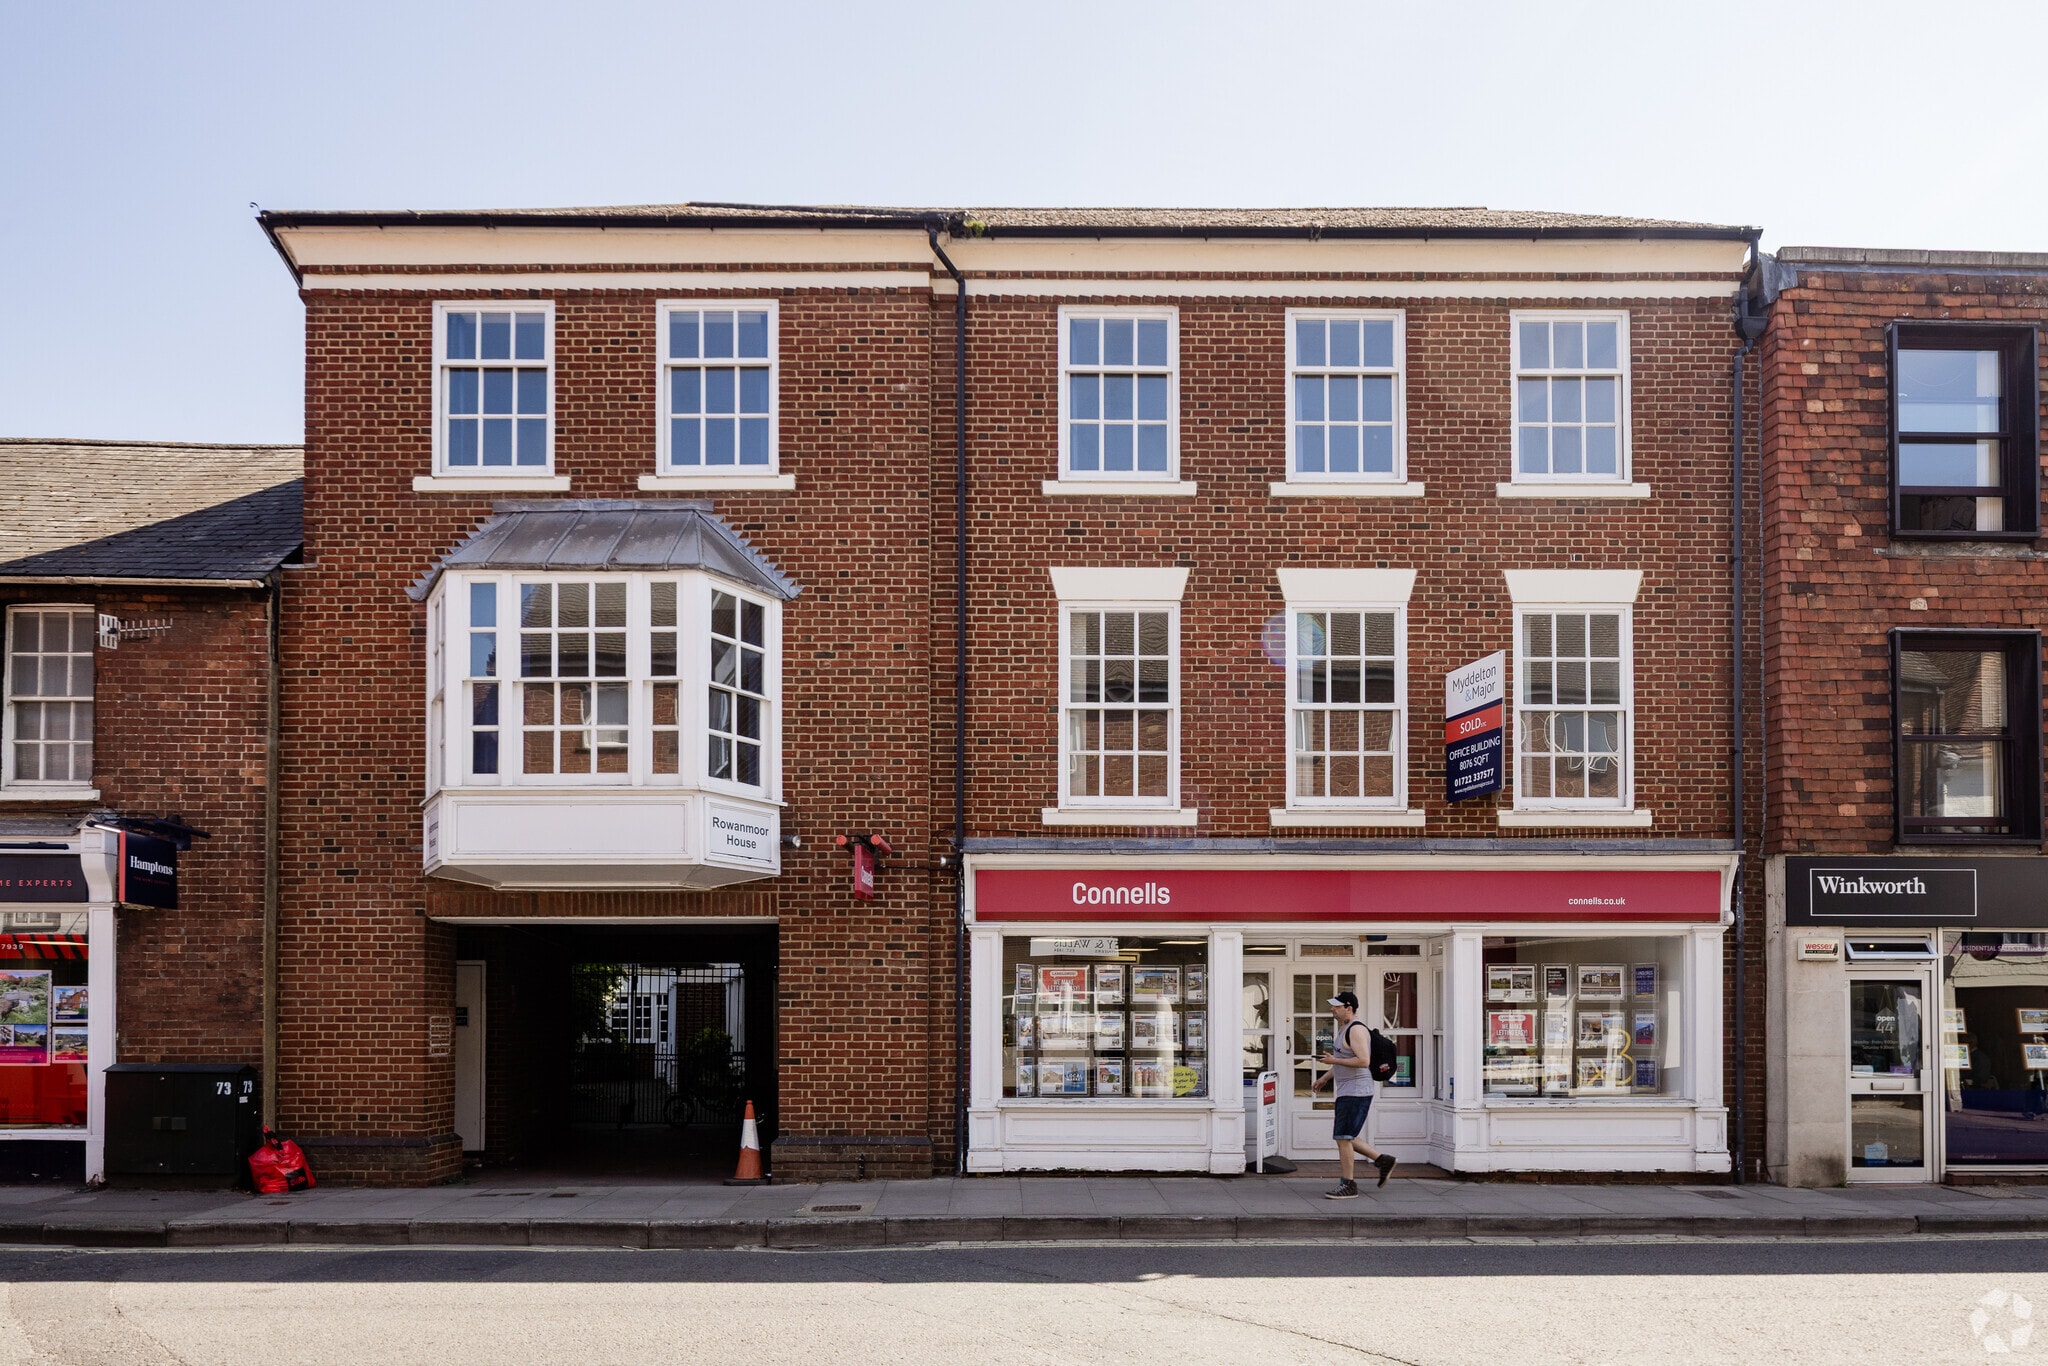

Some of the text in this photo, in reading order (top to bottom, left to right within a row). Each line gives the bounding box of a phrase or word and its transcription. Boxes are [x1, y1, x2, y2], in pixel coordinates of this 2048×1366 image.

[1452, 665, 1497, 693] Myddelton
[1460, 717, 1481, 734] SOLD
[1449, 736, 1500, 761] OFFICE BUILDING
[1459, 753, 1490, 771] 8076 SQFT
[1454, 768, 1494, 787] 01722 337577
[712, 816, 769, 836] Rowanmoor
[726, 834, 757, 849] House
[130, 855, 173, 875] Hamptons
[18, 879, 73, 887] EXPERTS
[1817, 876, 1927, 894] Winkworth
[1072, 882, 1171, 905] Connells
[1568, 897, 1626, 905] connells.co.uk
[216, 1082, 232, 1095] 73
[243, 1080, 253, 1093] 73
